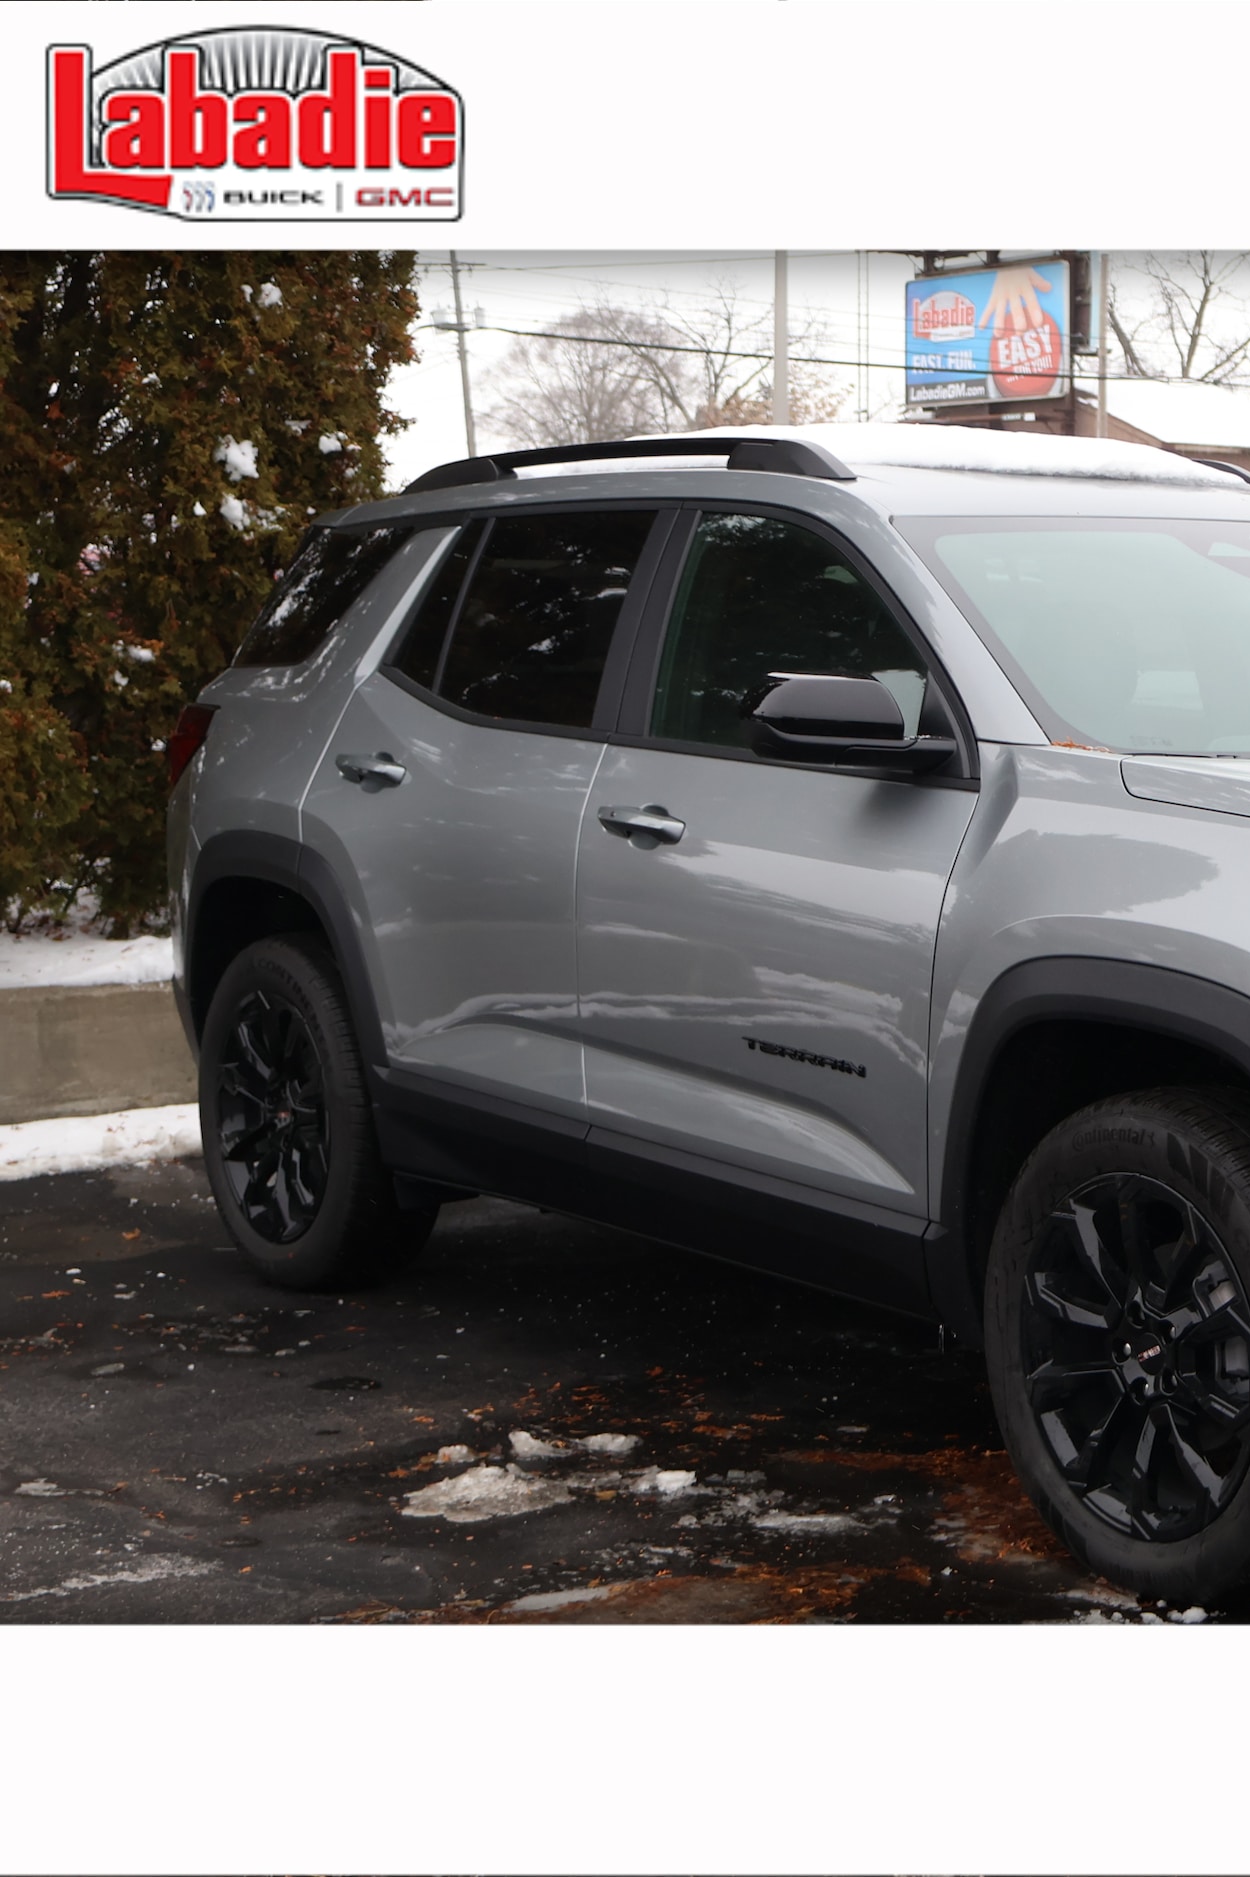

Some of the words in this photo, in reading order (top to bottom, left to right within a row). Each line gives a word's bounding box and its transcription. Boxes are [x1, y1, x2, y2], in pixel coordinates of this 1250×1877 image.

[912, 295, 975, 340] Labadie
[997, 324, 1053, 369] EASY
[910, 382, 986, 401] LabadieGM.com
[741, 1036, 867, 1078] TERRAIN
